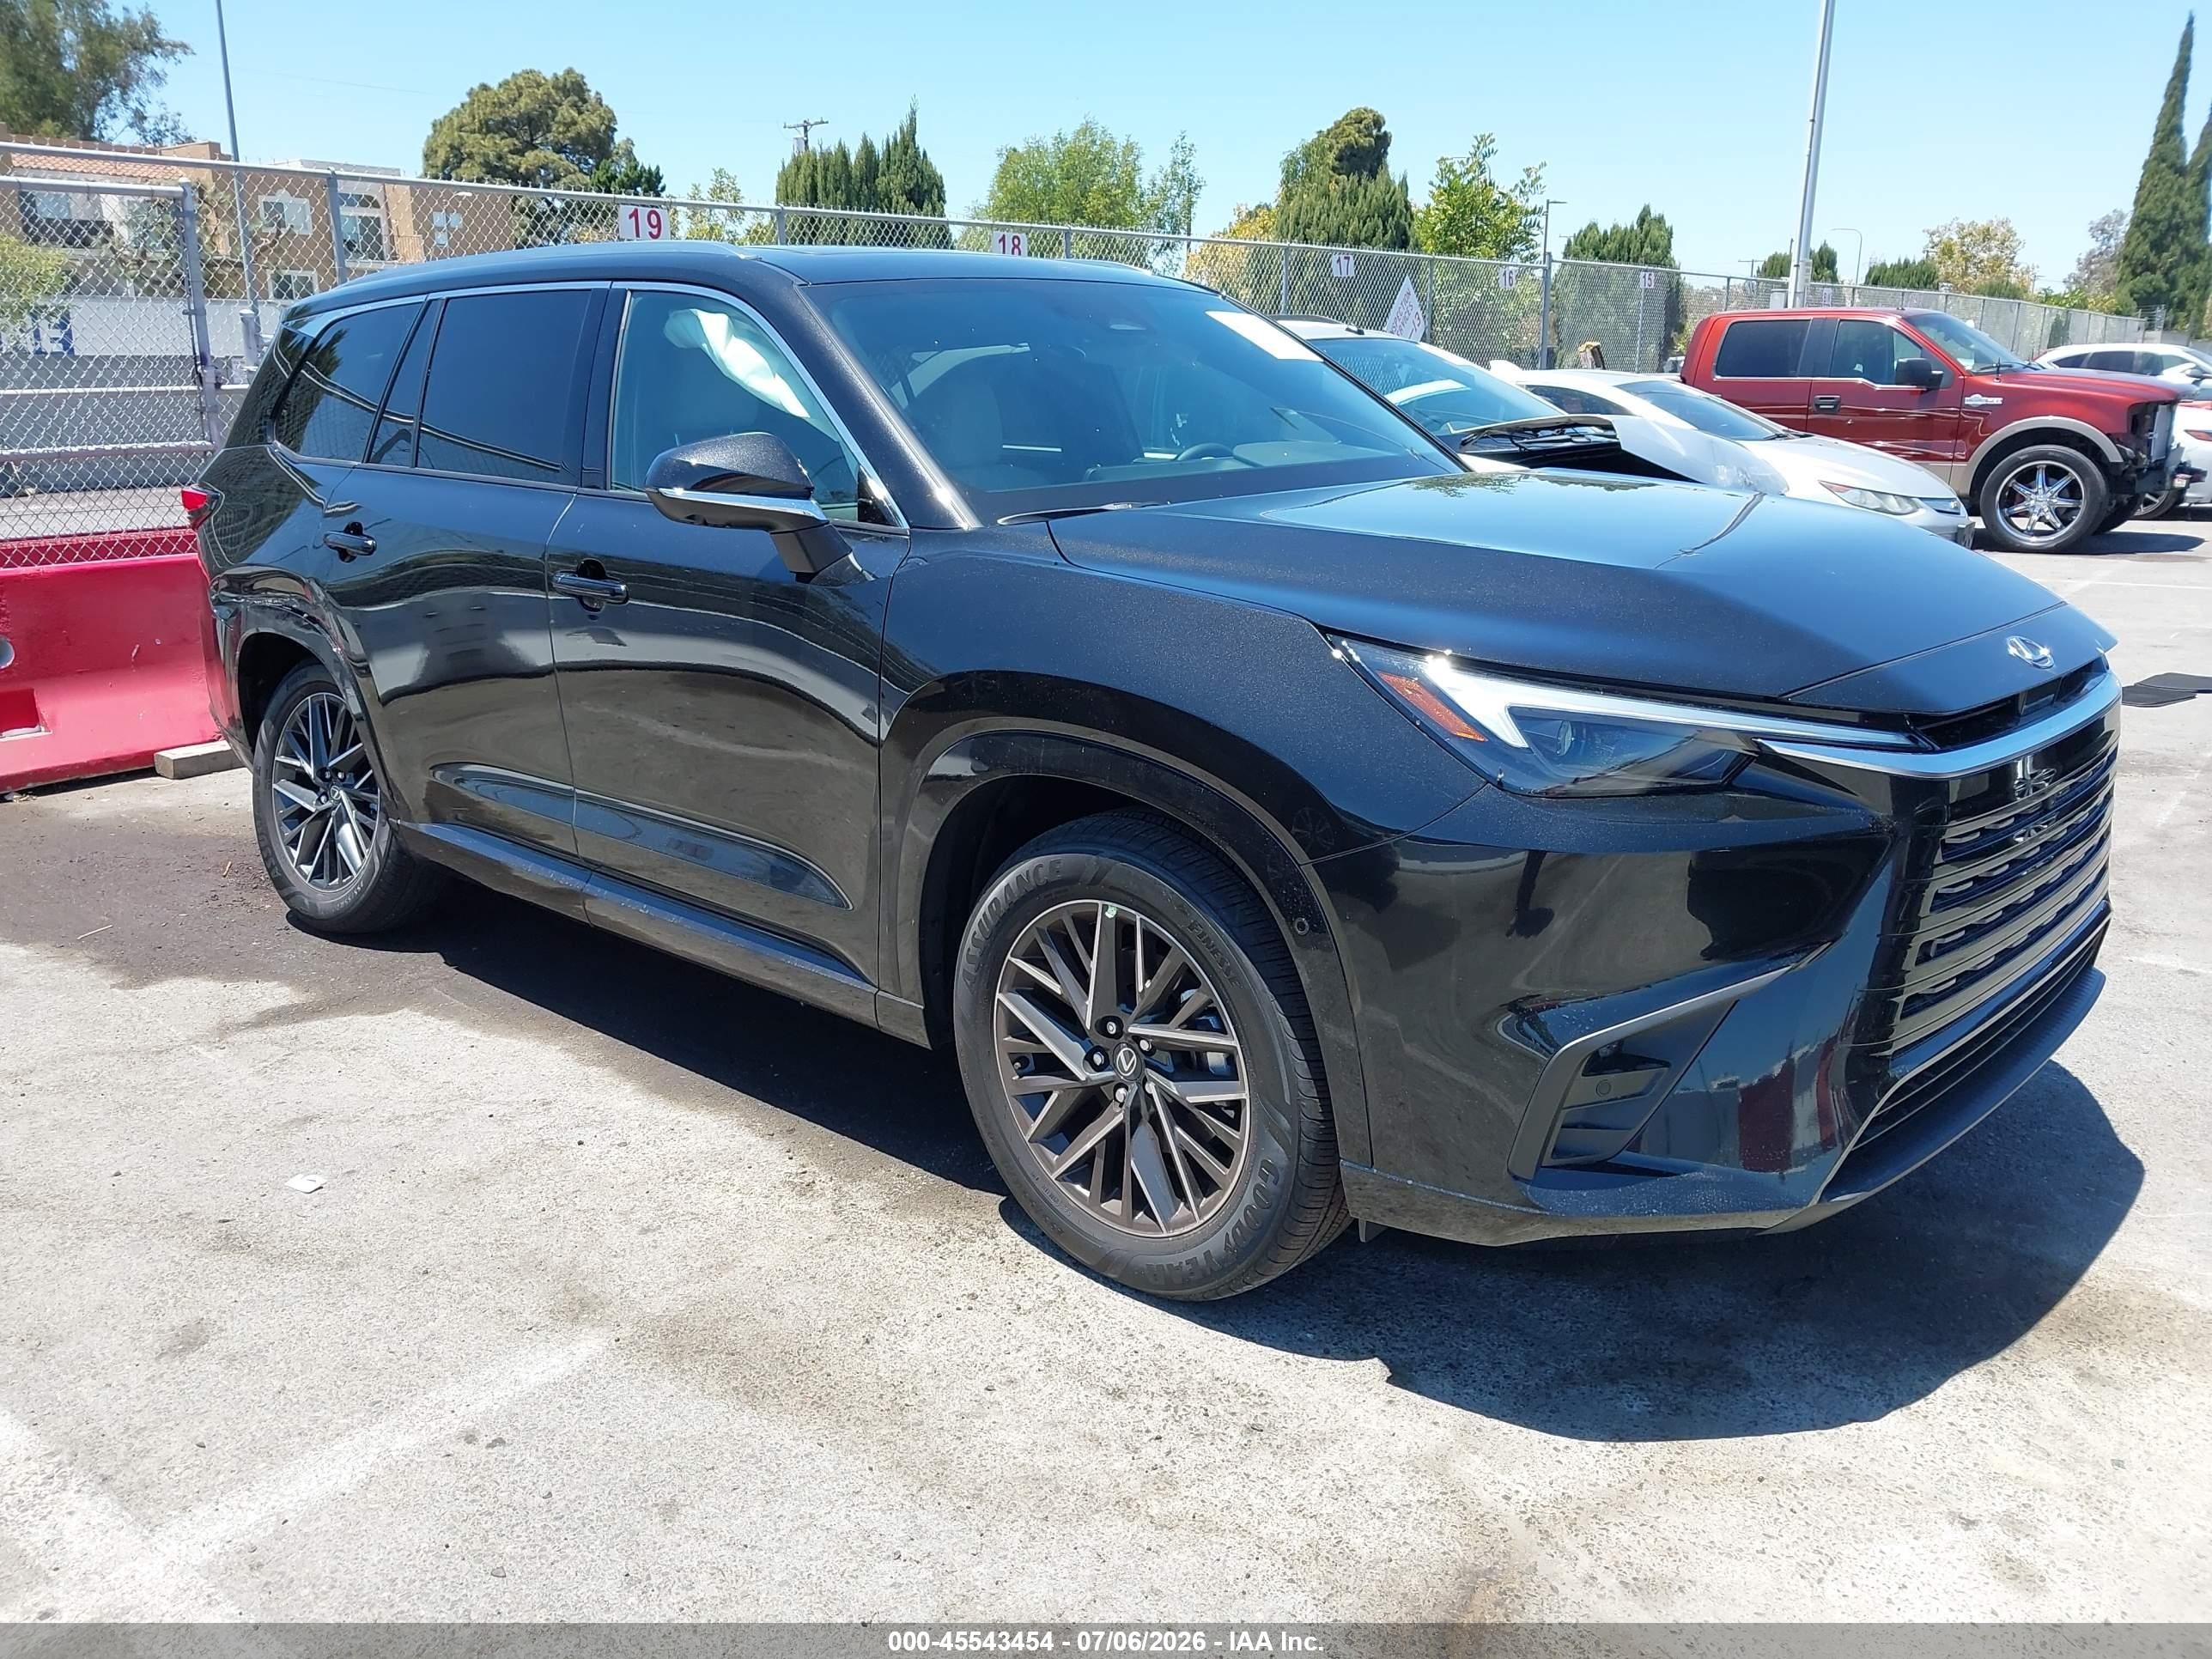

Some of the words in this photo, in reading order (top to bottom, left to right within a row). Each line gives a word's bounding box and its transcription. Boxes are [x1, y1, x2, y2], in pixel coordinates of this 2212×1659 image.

[629, 208, 662, 240] 19
[998, 234, 1022, 256] 18
[1336, 256, 1351, 276] 17
[1502, 270, 1514, 288] 16
[1643, 273, 1653, 288] 15
[961, 858, 1066, 994] ASSURANCE
